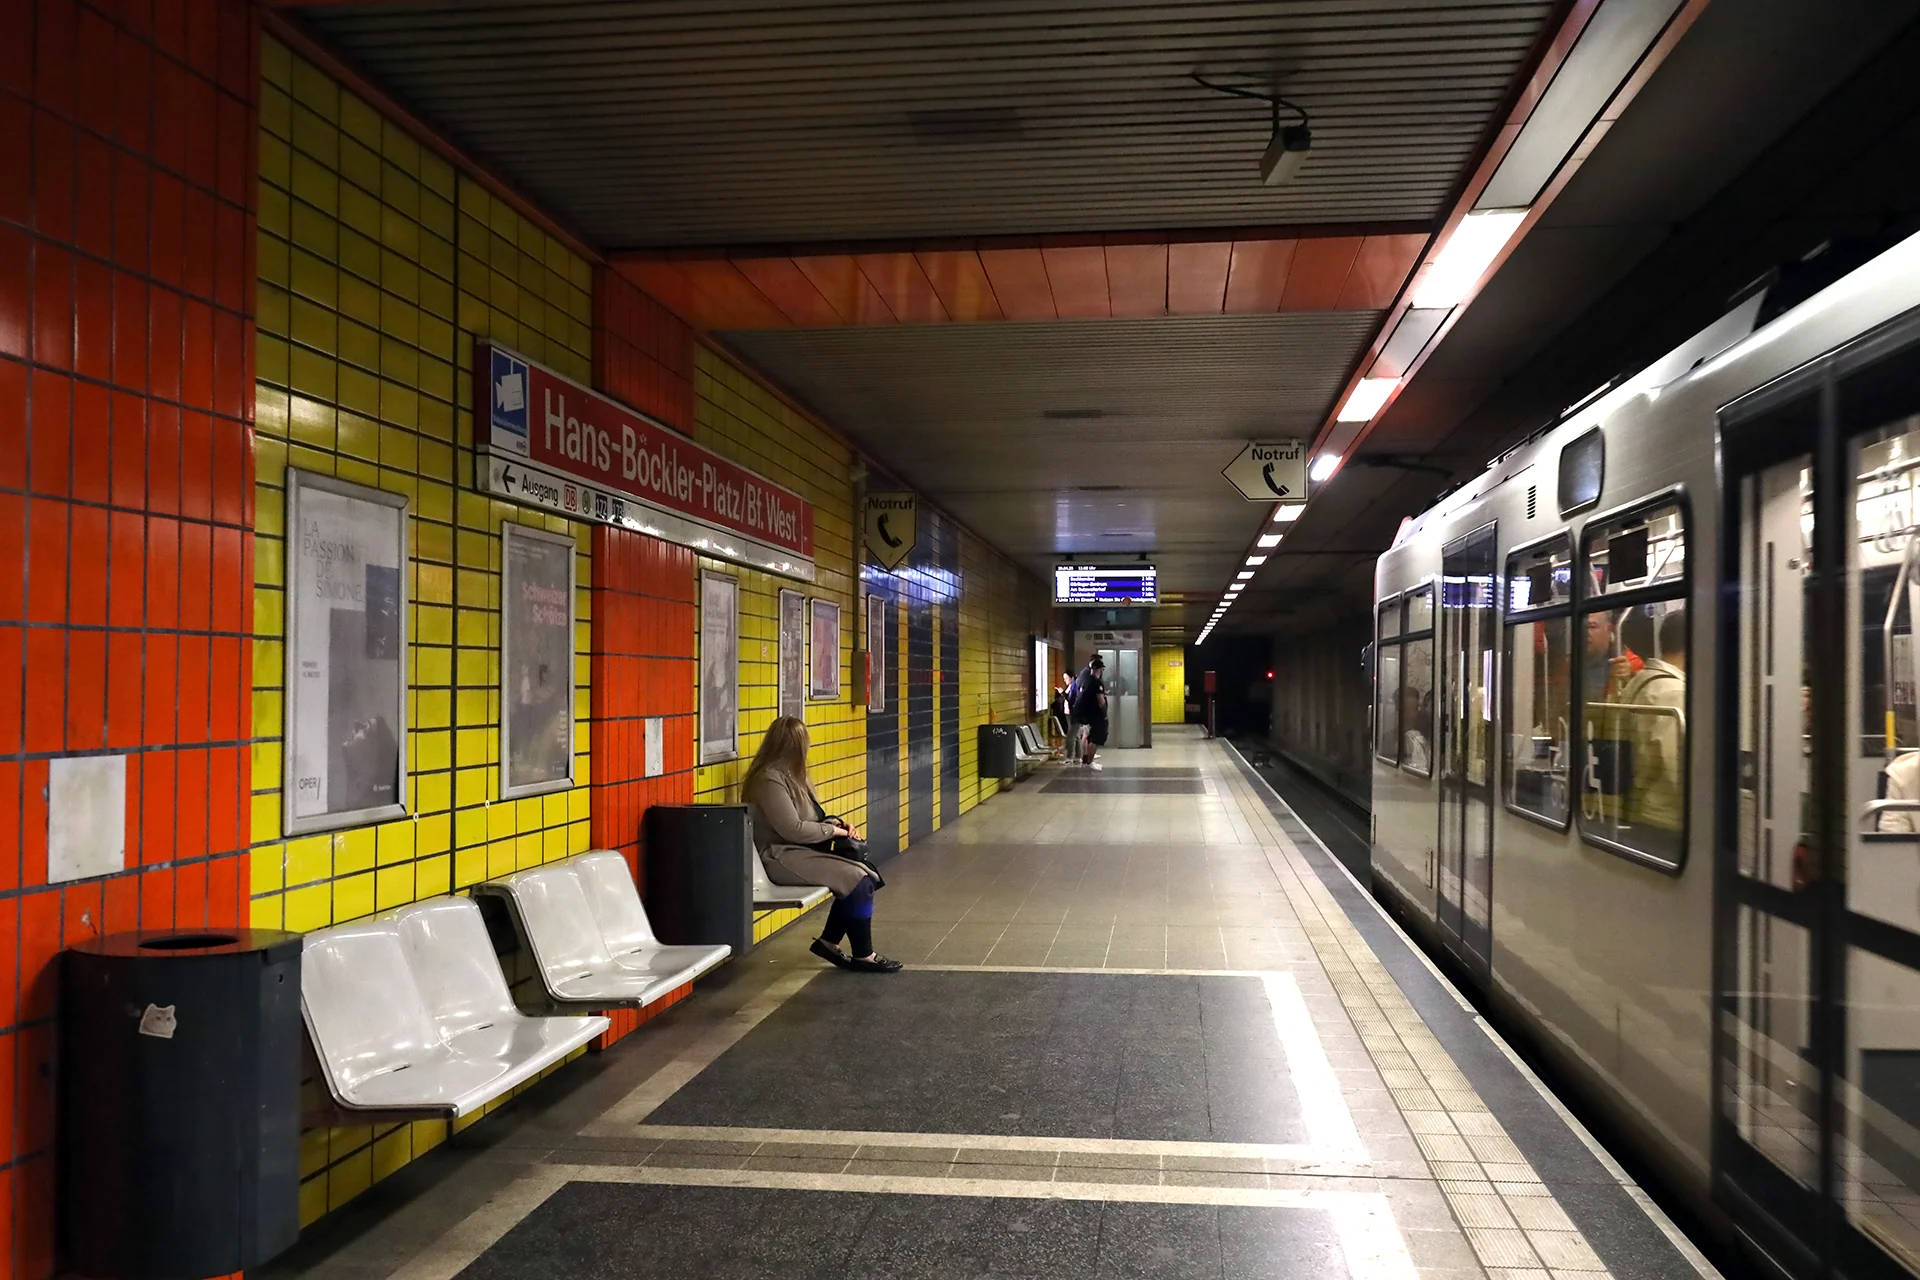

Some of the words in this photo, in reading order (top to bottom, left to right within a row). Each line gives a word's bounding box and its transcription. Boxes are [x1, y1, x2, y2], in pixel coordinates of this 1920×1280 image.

[1252, 448, 1300, 460] Notruf
[521, 474, 559, 507] Ausgang
[564, 485, 577, 510] DB
[596, 498, 607, 516] 172
[868, 497, 914, 510] Notruf
[303, 517, 320, 539] LA
[765, 491, 797, 543] West
[303, 537, 356, 562] PASSION
[316, 561, 332, 580] DE
[316, 579, 363, 602] SIMONE
